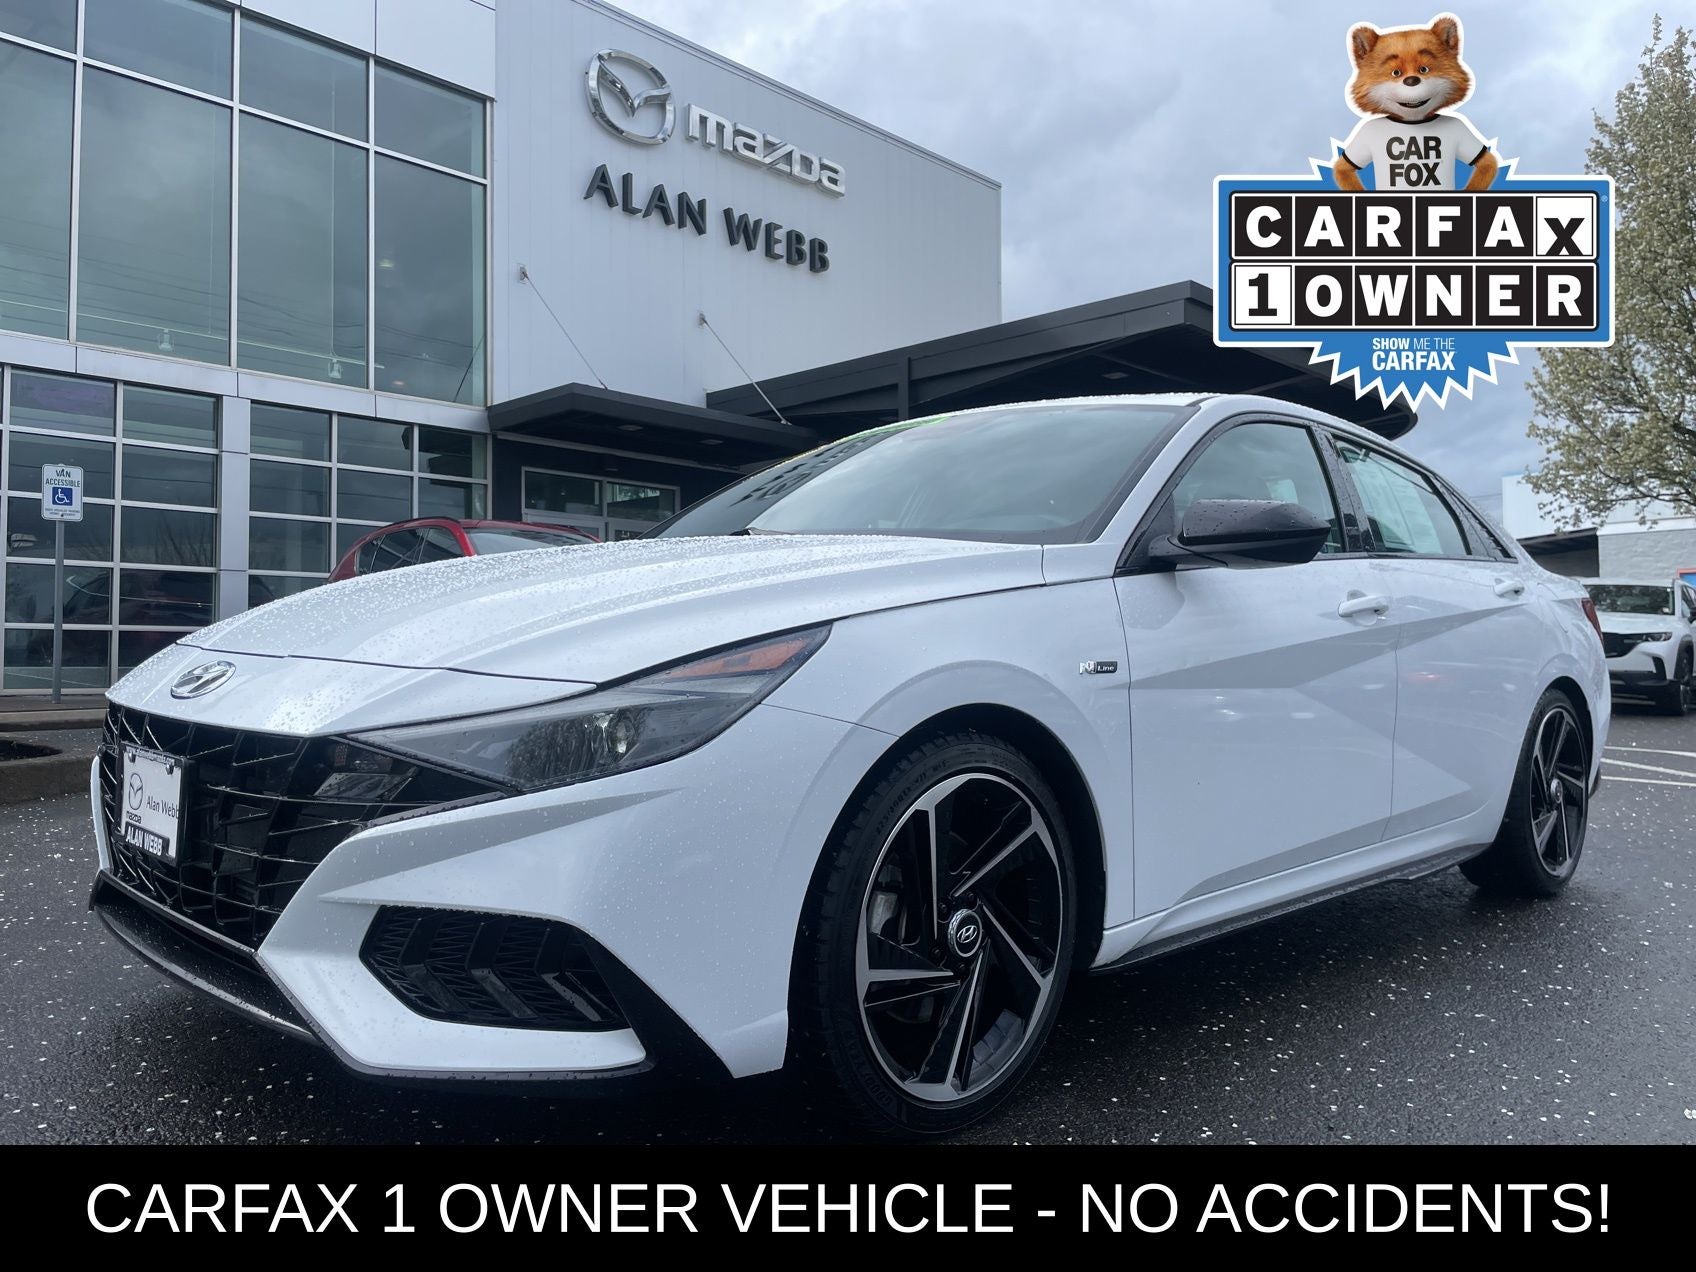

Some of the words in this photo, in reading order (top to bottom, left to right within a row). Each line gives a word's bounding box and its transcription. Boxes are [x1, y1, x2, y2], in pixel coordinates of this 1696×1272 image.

[686, 103, 846, 198] mazda
[583, 163, 707, 236] ALAN
[722, 207, 830, 274] WEBB
[45, 478, 80, 487] ACCESSIBLE
[55, 469, 71, 478] VAN
[146, 795, 160, 812] Alan
[125, 825, 144, 848] ALAN
[144, 832, 163, 856] WEBB
